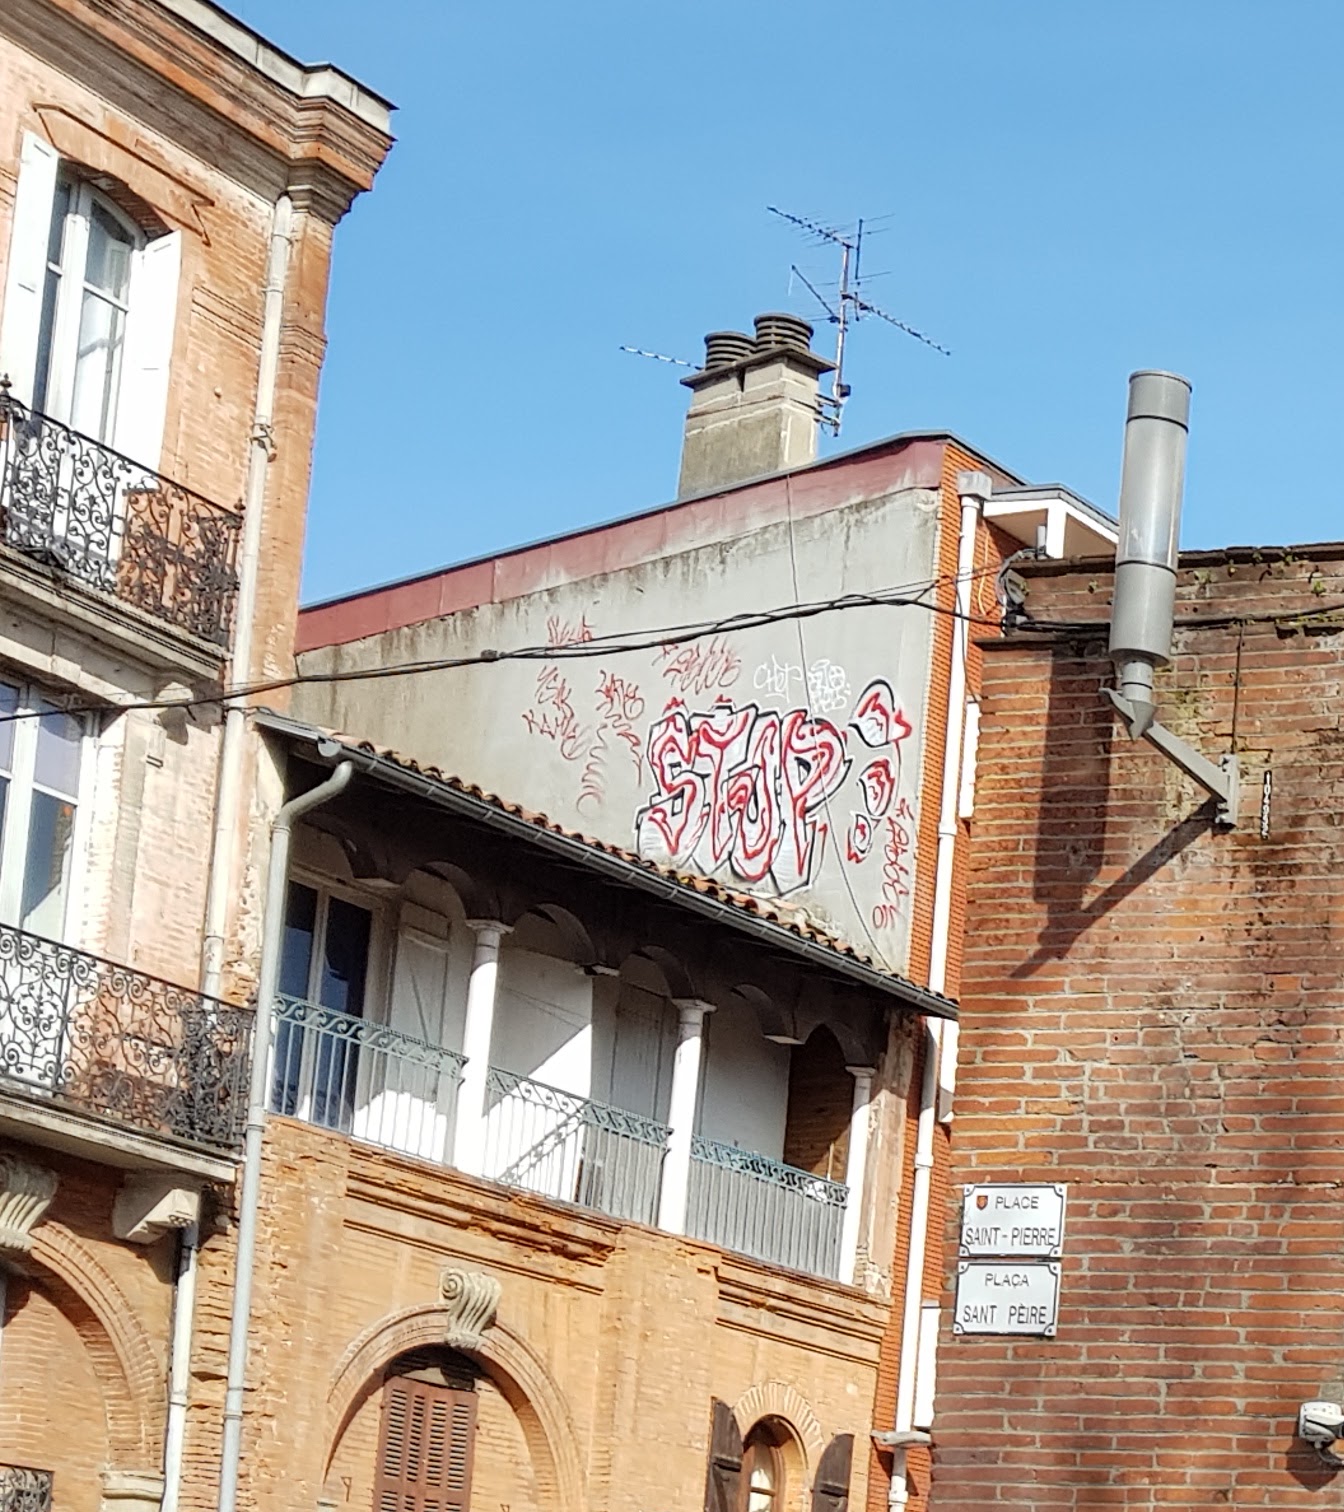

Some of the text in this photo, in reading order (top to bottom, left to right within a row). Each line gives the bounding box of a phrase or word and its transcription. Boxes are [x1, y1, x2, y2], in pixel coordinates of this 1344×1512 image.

[995, 1195, 1040, 1210] PLACE
[984, 1273, 1030, 1290] PLAÇA
[963, 1302, 1048, 1325] SANT PÈIRE
